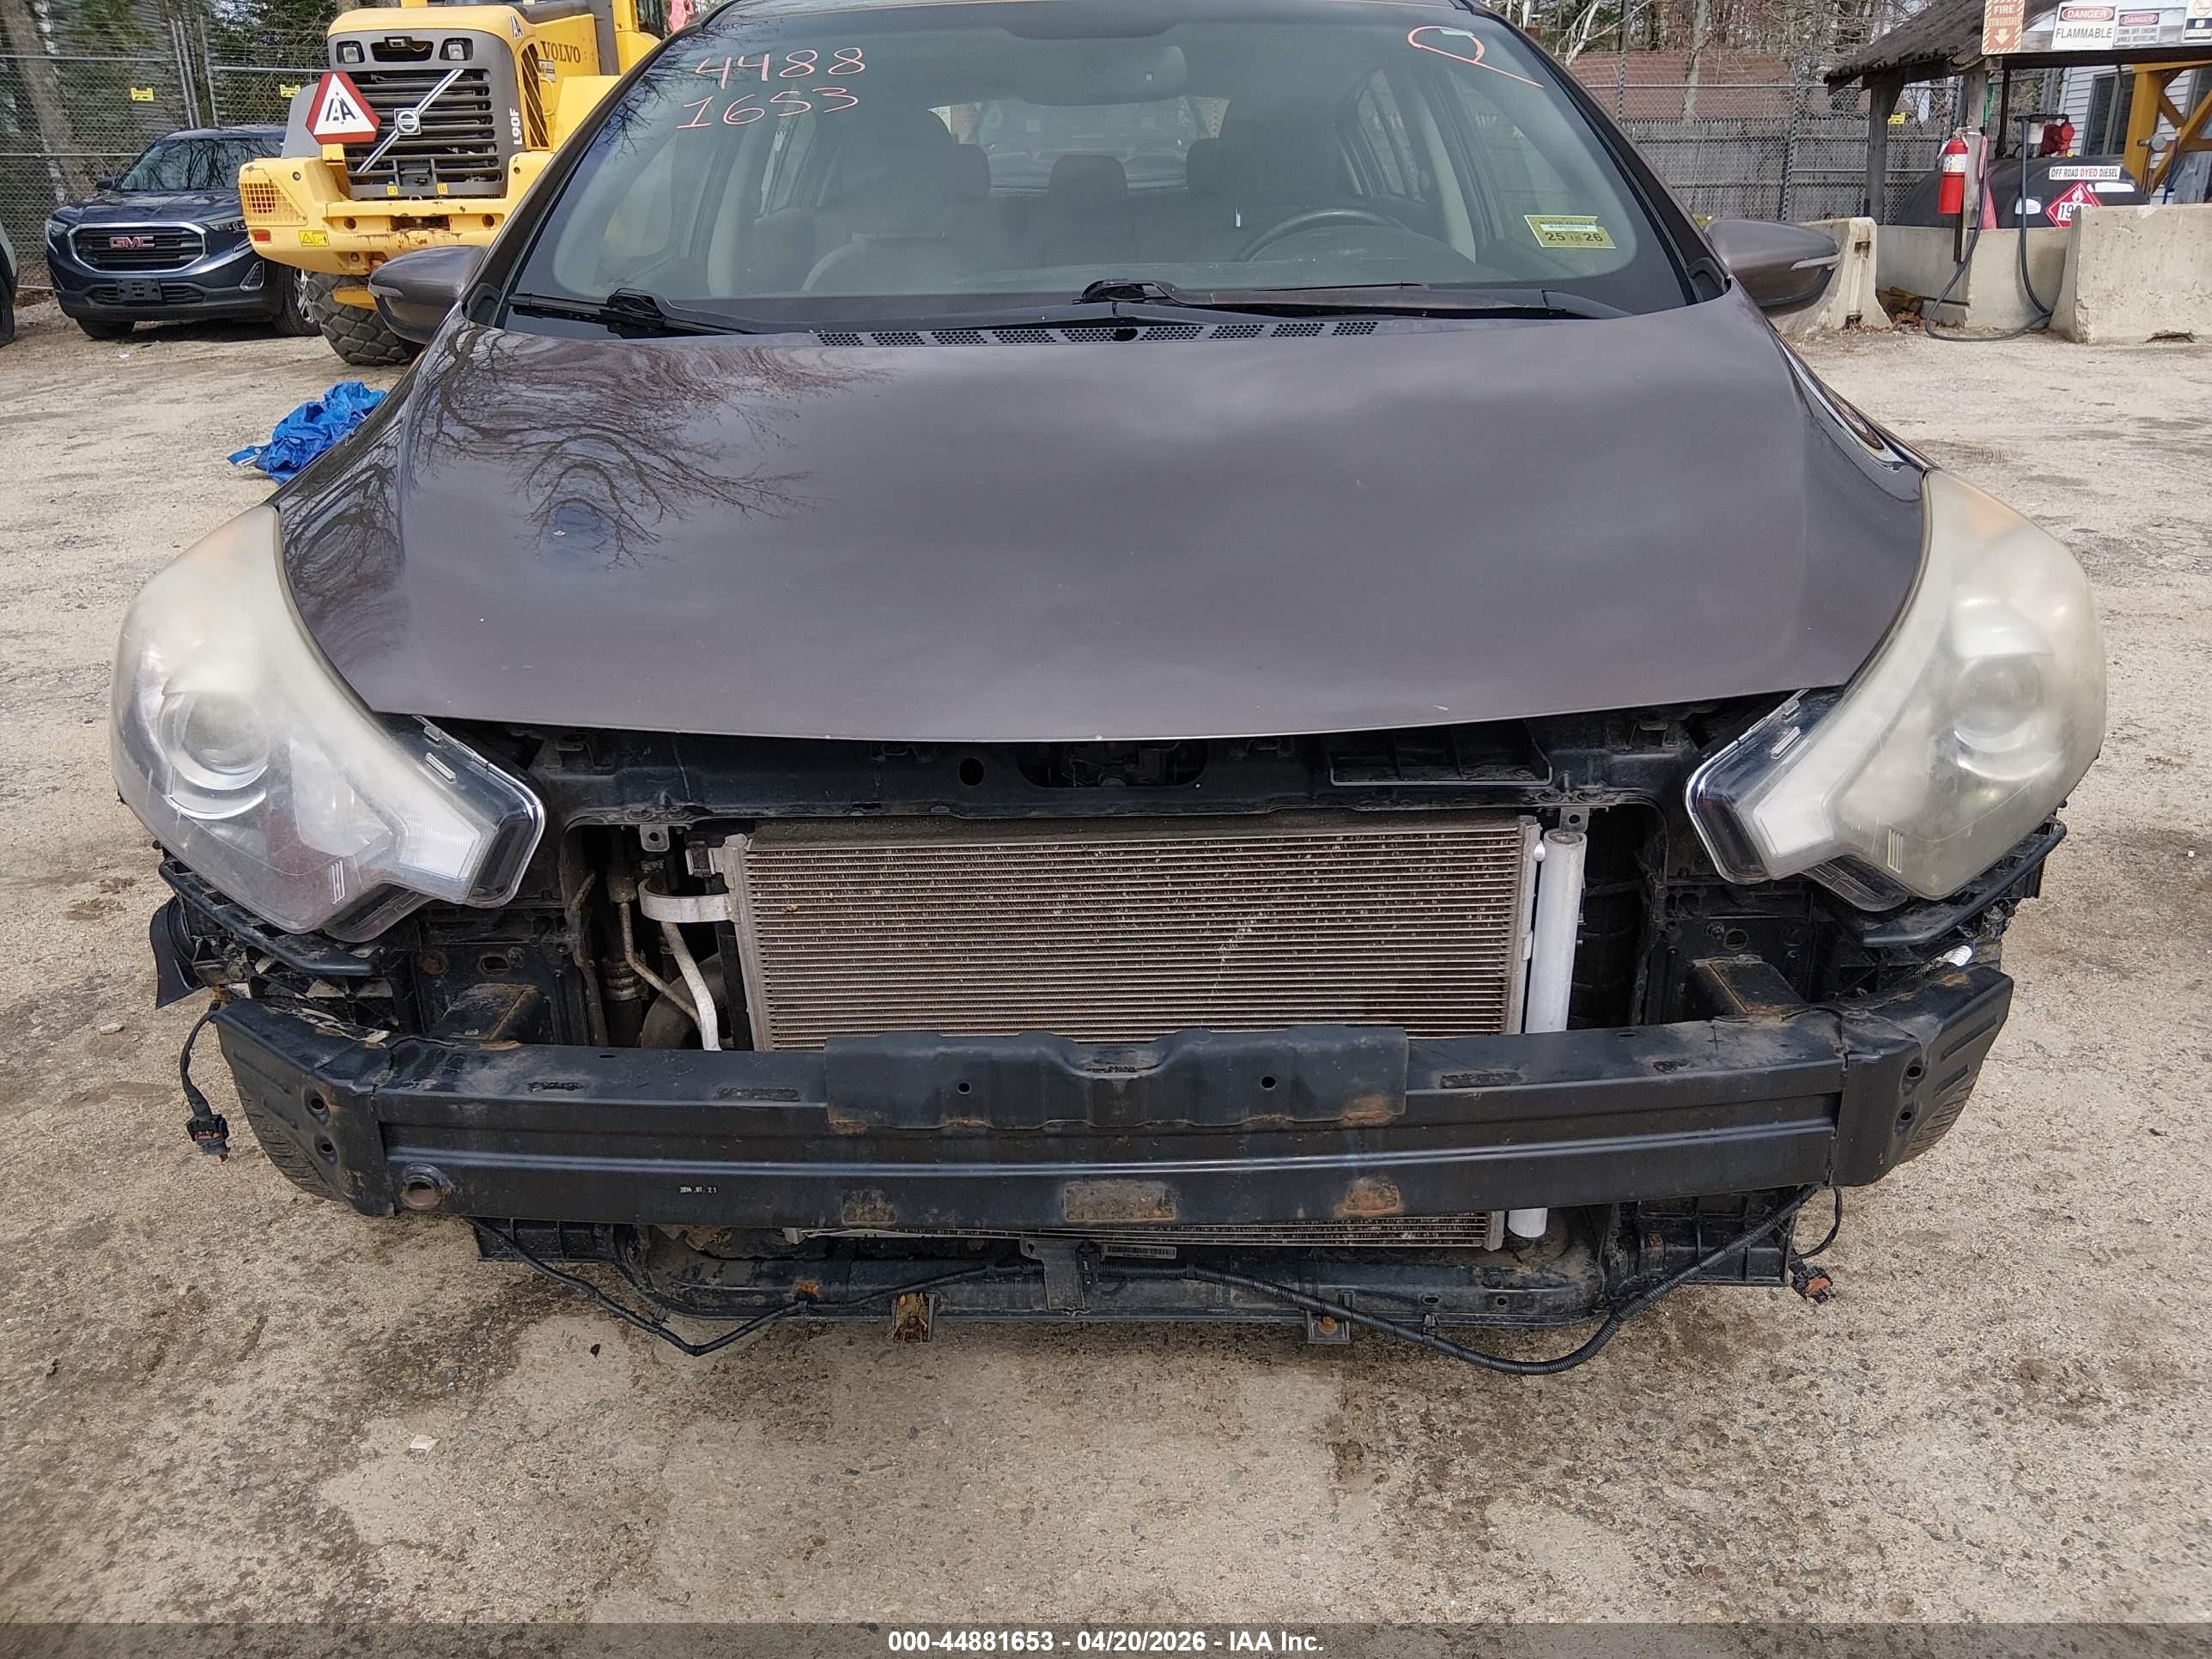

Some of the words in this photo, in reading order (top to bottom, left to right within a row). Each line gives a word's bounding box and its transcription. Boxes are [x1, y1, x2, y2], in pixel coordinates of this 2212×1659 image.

[1993, 5, 2014, 15] FIRE
[2067, 9, 2107, 19] DANGER
[2122, 15, 2156, 24] DANGER
[2056, 27, 2113, 39] FLAMMABLE
[540, 40, 581, 64] VOLVO
[695, 47, 866, 89] 4488
[677, 87, 859, 129] 1653
[509, 108, 523, 145] L90F
[2051, 168, 2063, 178] OFF
[2063, 168, 2079, 178] ROAD
[2080, 168, 2098, 177] DYED
[2099, 168, 2118, 178] DIESEL
[109, 235, 155, 248] GMC
[1546, 232, 1566, 241] 25
[1583, 233, 1604, 242] 26
